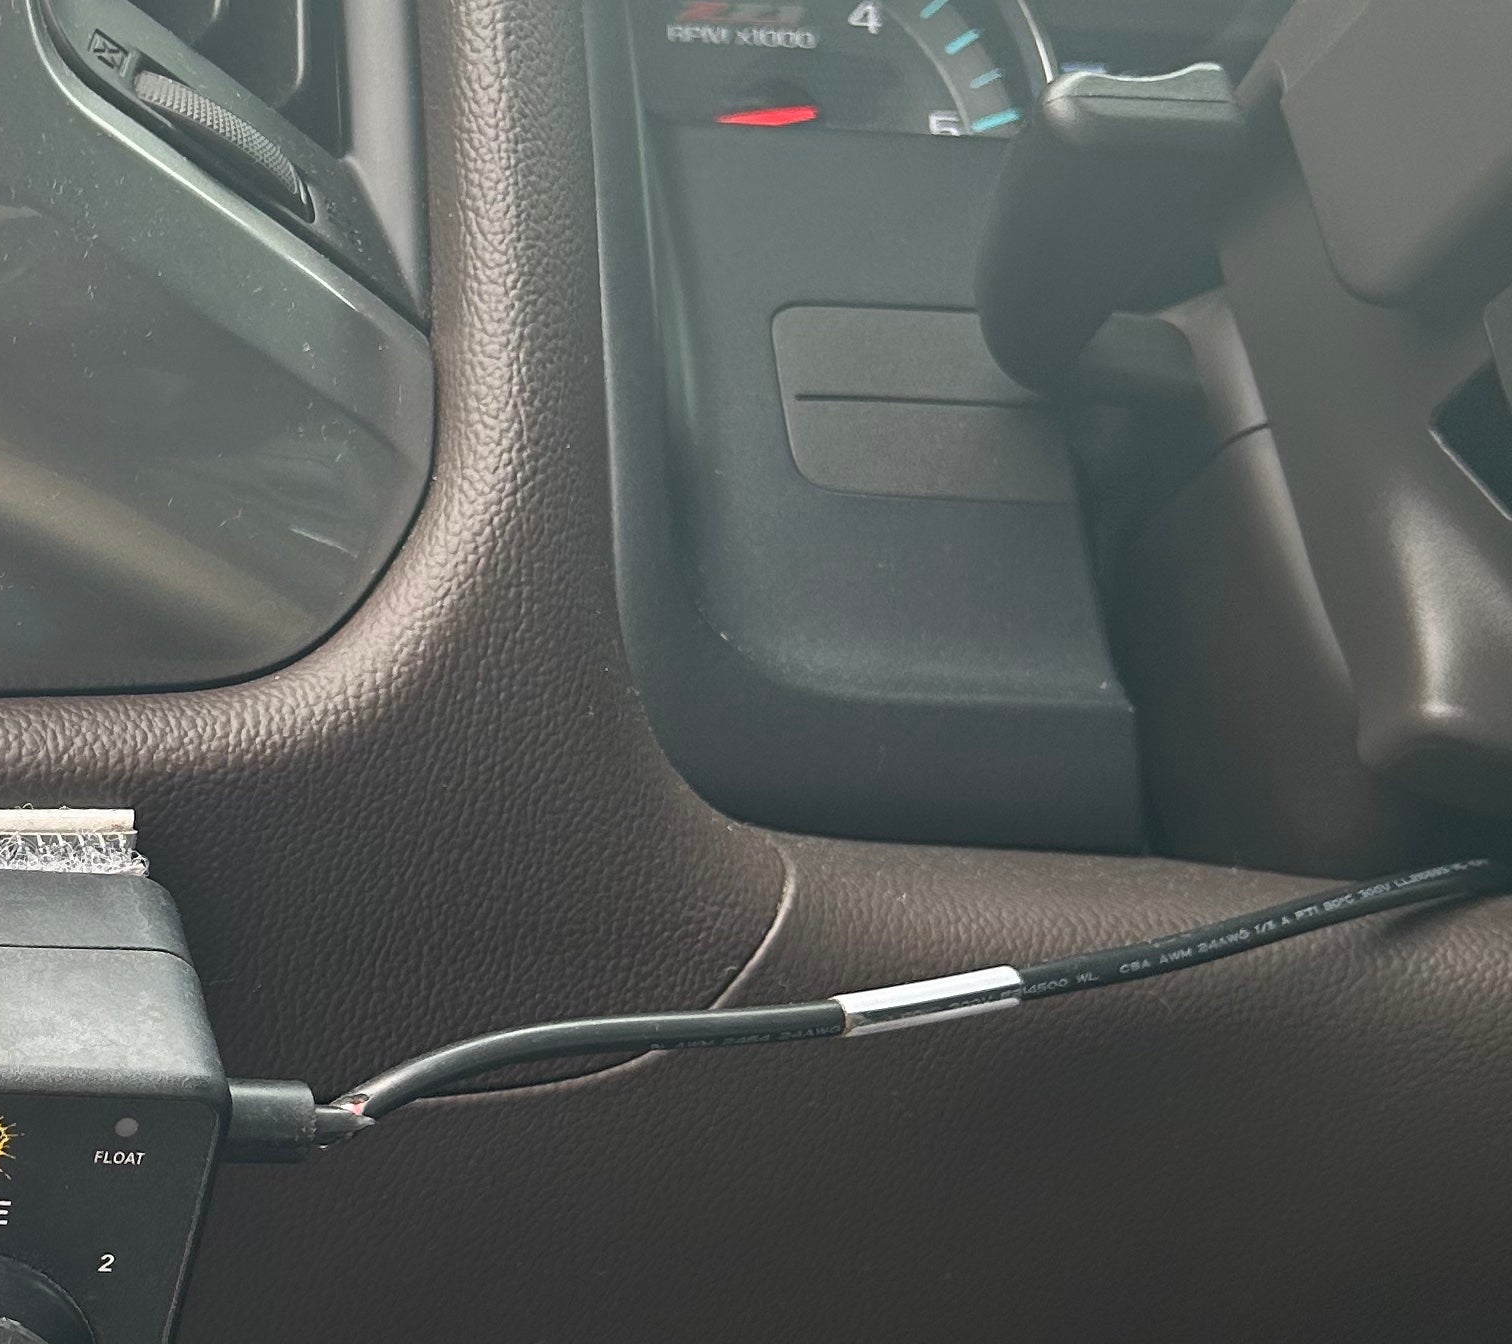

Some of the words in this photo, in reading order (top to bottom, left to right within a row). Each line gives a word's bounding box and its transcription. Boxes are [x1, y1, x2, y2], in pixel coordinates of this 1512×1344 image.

[848, 0, 883, 35] 4
[93, 1150, 146, 1165] FLOAT
[97, 1254, 116, 1273] 2
